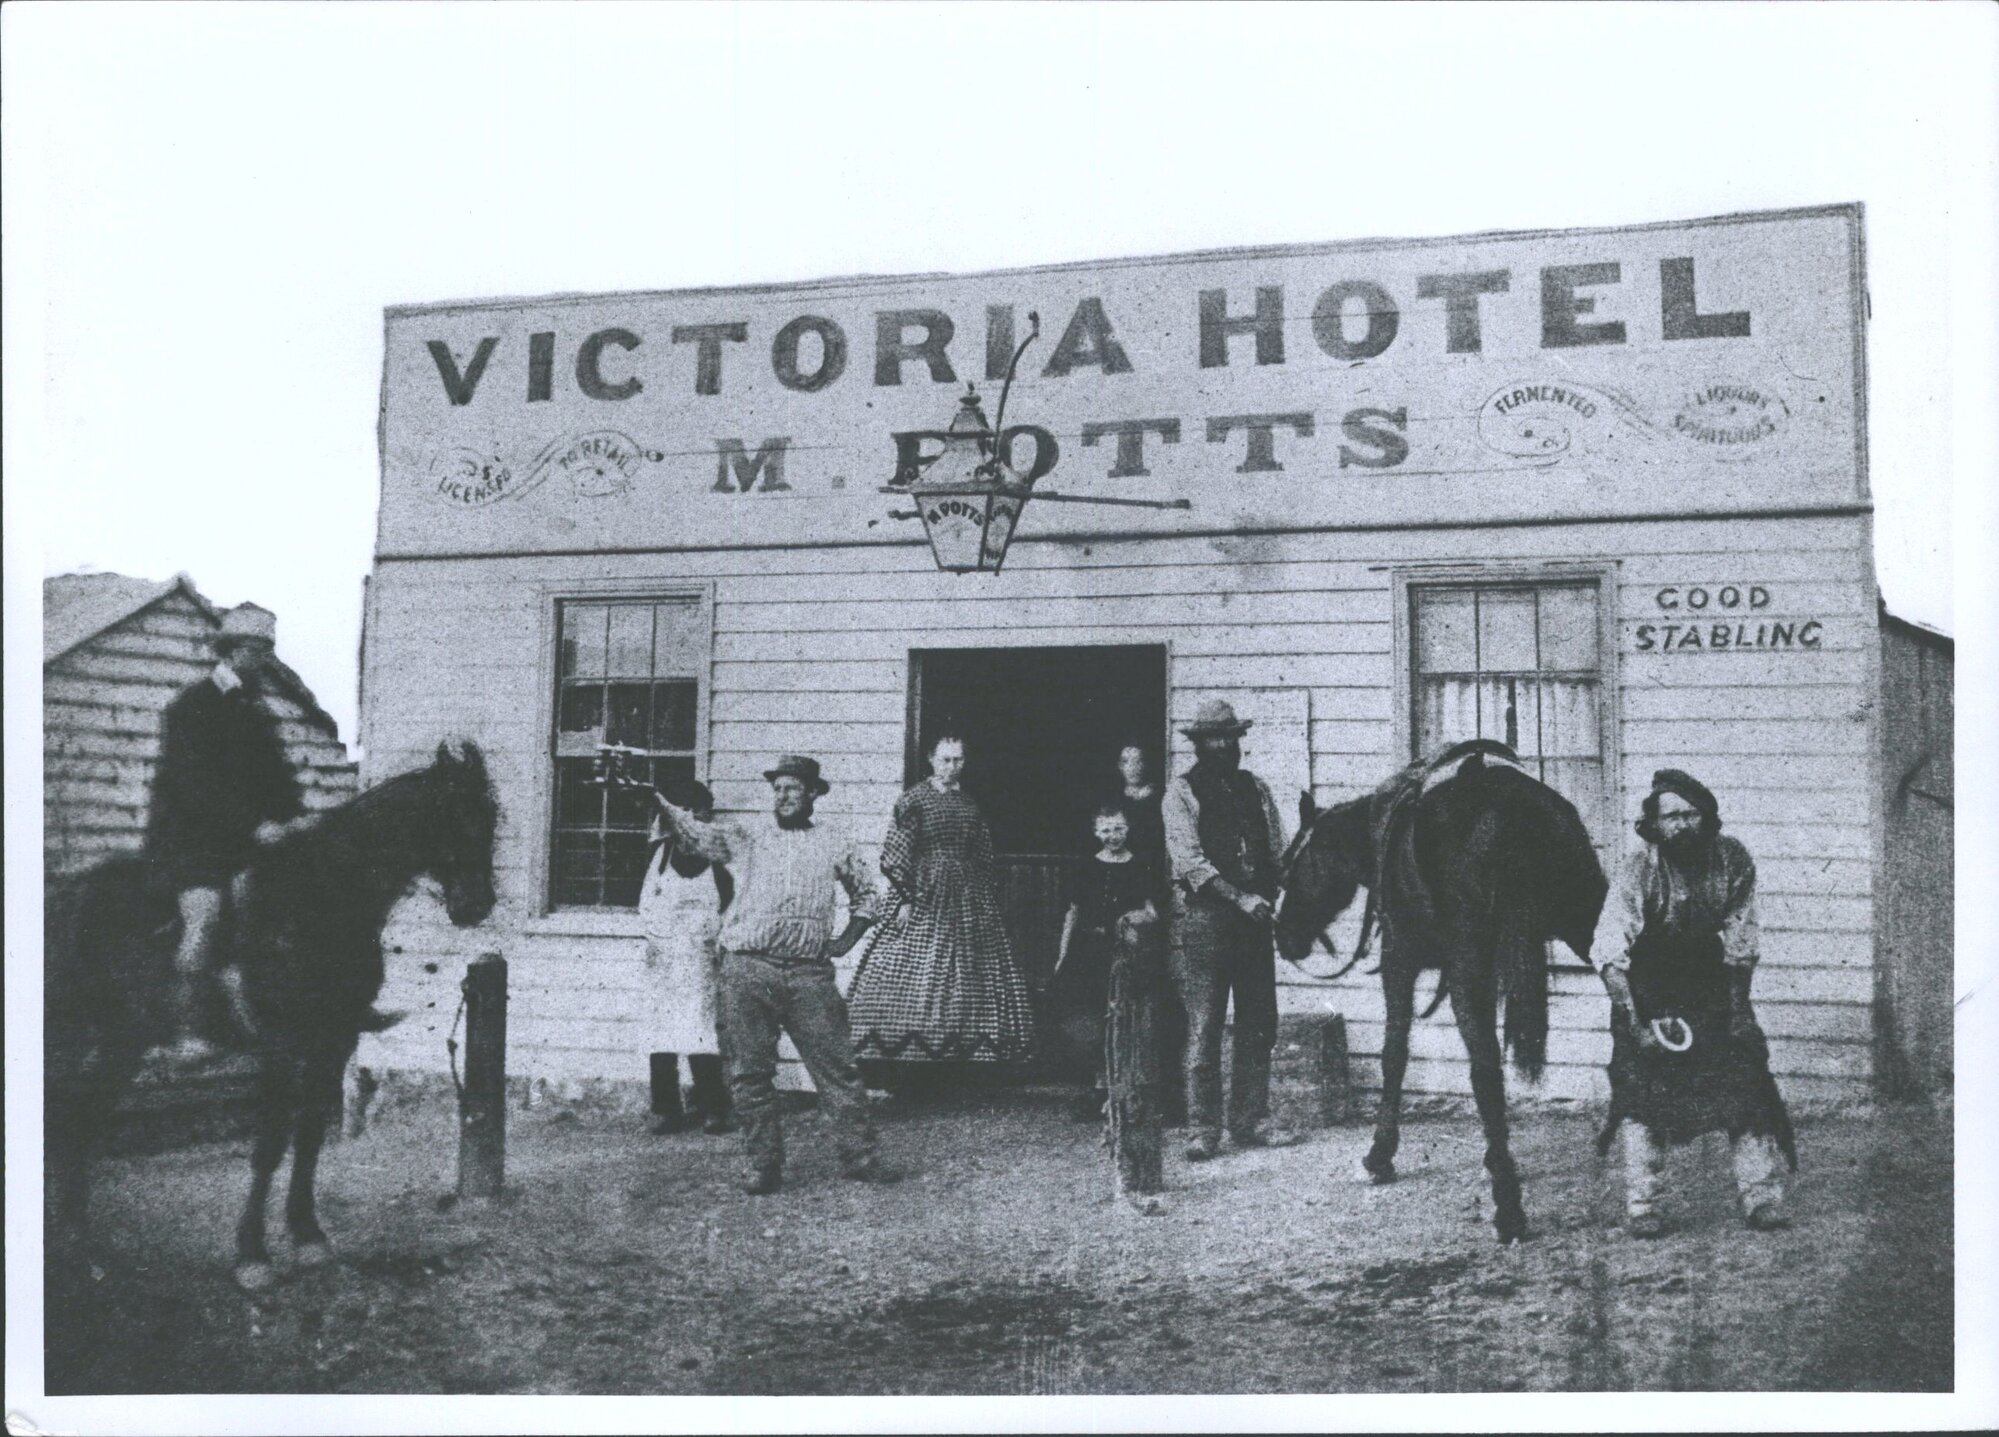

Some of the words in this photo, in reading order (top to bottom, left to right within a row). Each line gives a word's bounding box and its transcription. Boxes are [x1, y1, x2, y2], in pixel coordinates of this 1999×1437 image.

[427, 298, 1132, 406] VICTORIA
[1199, 257, 1752, 368] HOTEL
[1494, 386, 1597, 419] FERMENTED
[889, 407, 1410, 487] POTTS
[938, 501, 985, 527] POTTS
[1655, 586, 1770, 610] GOOD
[1635, 620, 1823, 651] STABLING
